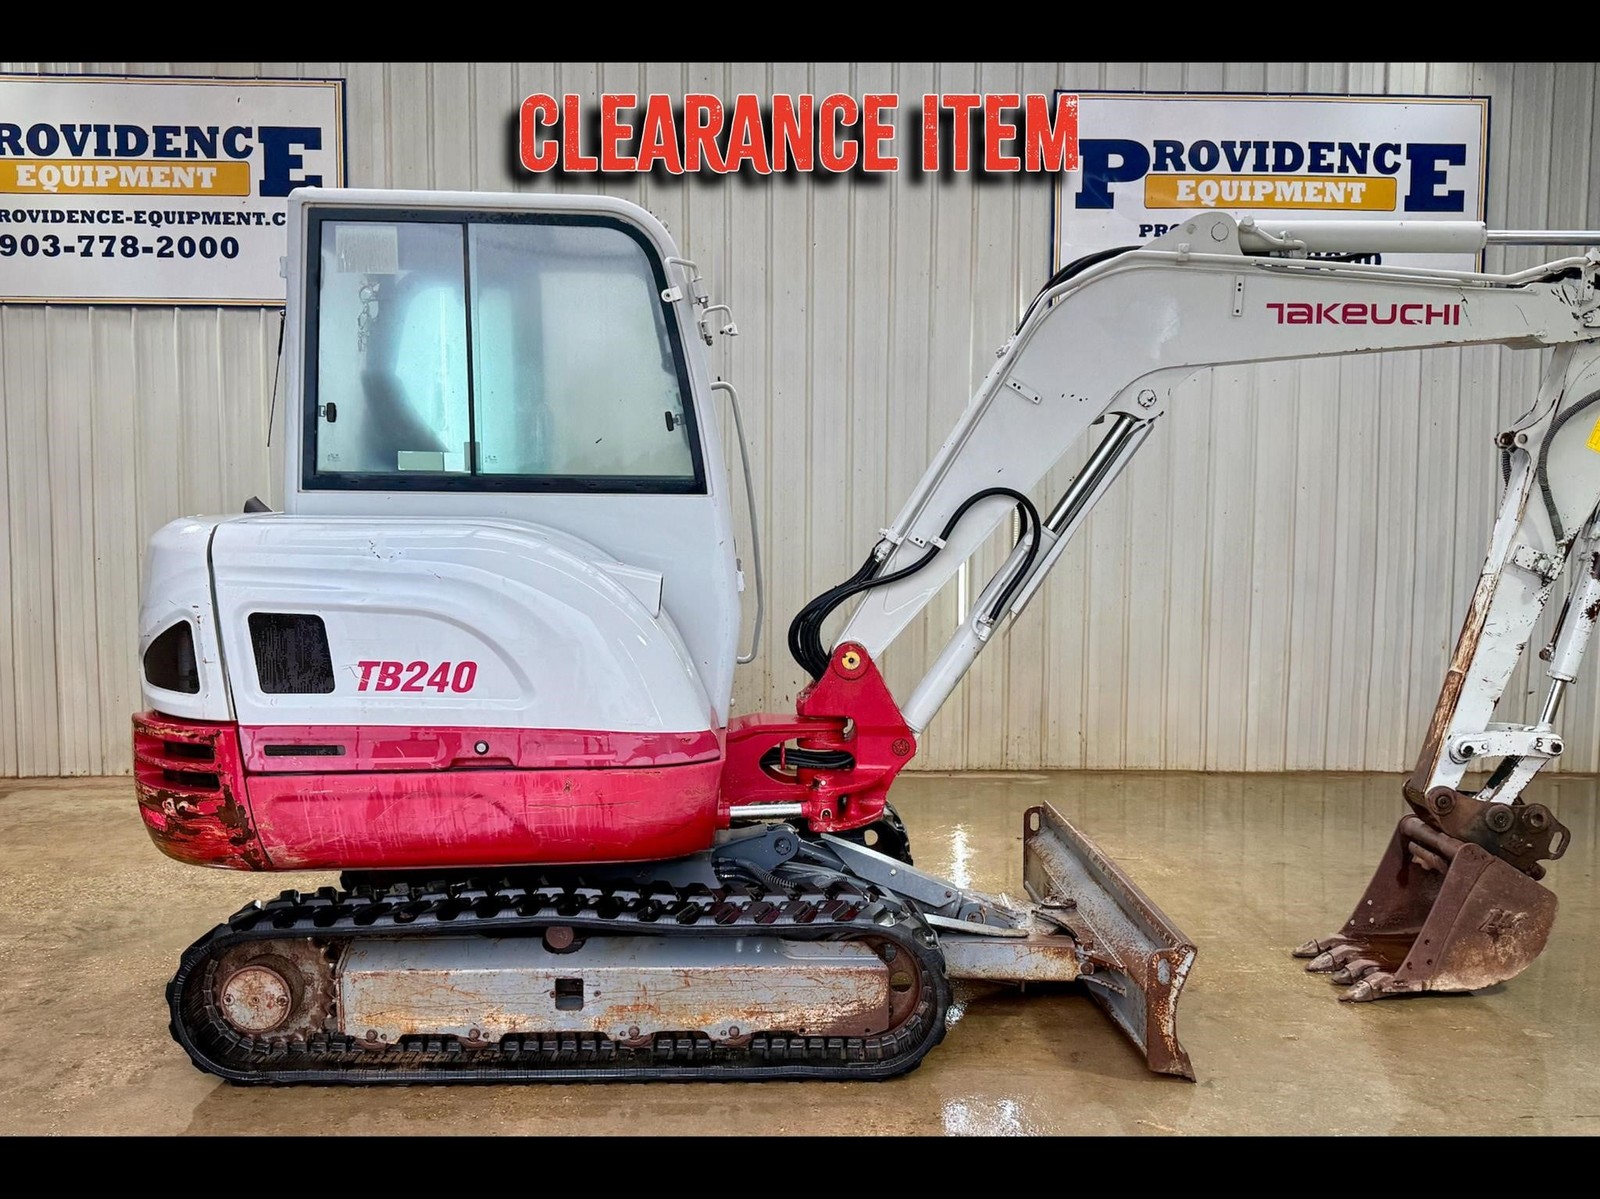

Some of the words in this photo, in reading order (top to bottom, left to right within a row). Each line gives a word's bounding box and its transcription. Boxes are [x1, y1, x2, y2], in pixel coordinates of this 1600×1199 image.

[16, 164, 217, 192] EQUIPMENT
[1075, 138, 1467, 213] PROVIDENCE
[1176, 179, 1367, 206] EQUIPMENT
[0, 233, 240, 259] 903-778-2000
[357, 660, 478, 693] TB240
